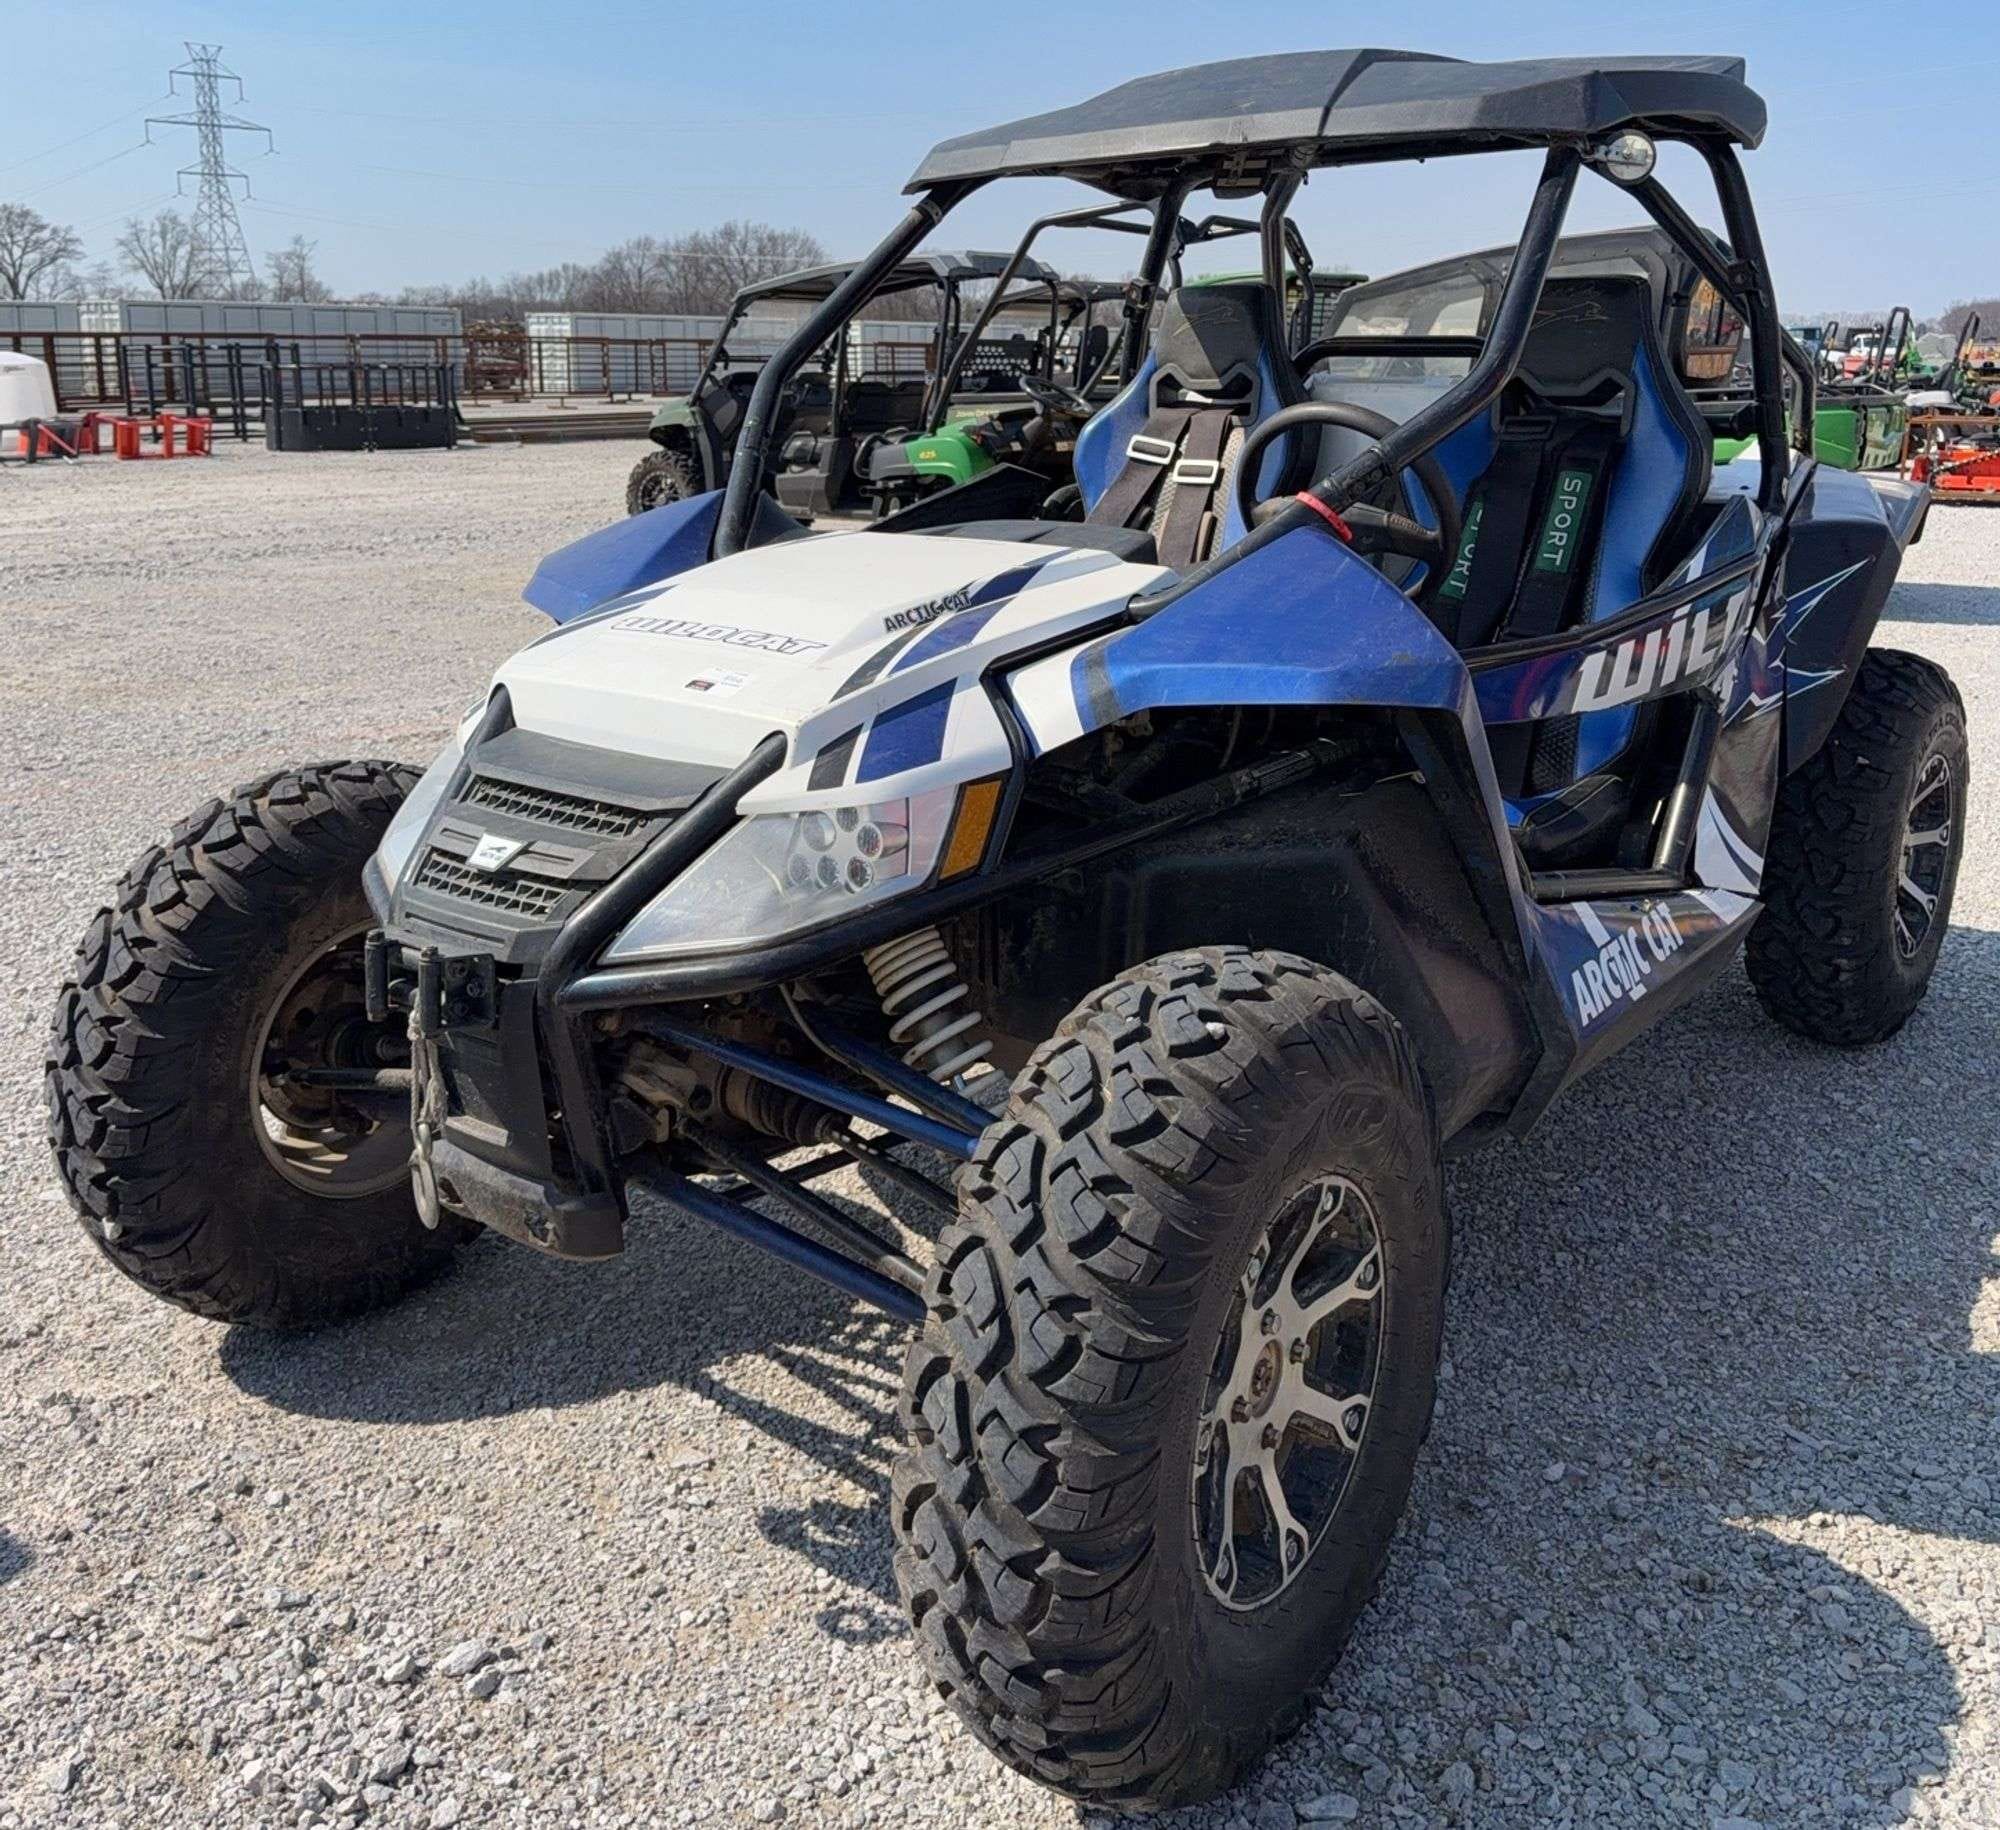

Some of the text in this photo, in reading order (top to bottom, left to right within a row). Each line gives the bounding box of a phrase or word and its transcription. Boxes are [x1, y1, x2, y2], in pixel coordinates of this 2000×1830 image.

[1543, 478, 1582, 566] SPORT
[611, 616, 828, 655] WILDCAT
[884, 590, 972, 633] ARCTIC CAT
[1571, 901, 1684, 1027] ARCTIC CAT
